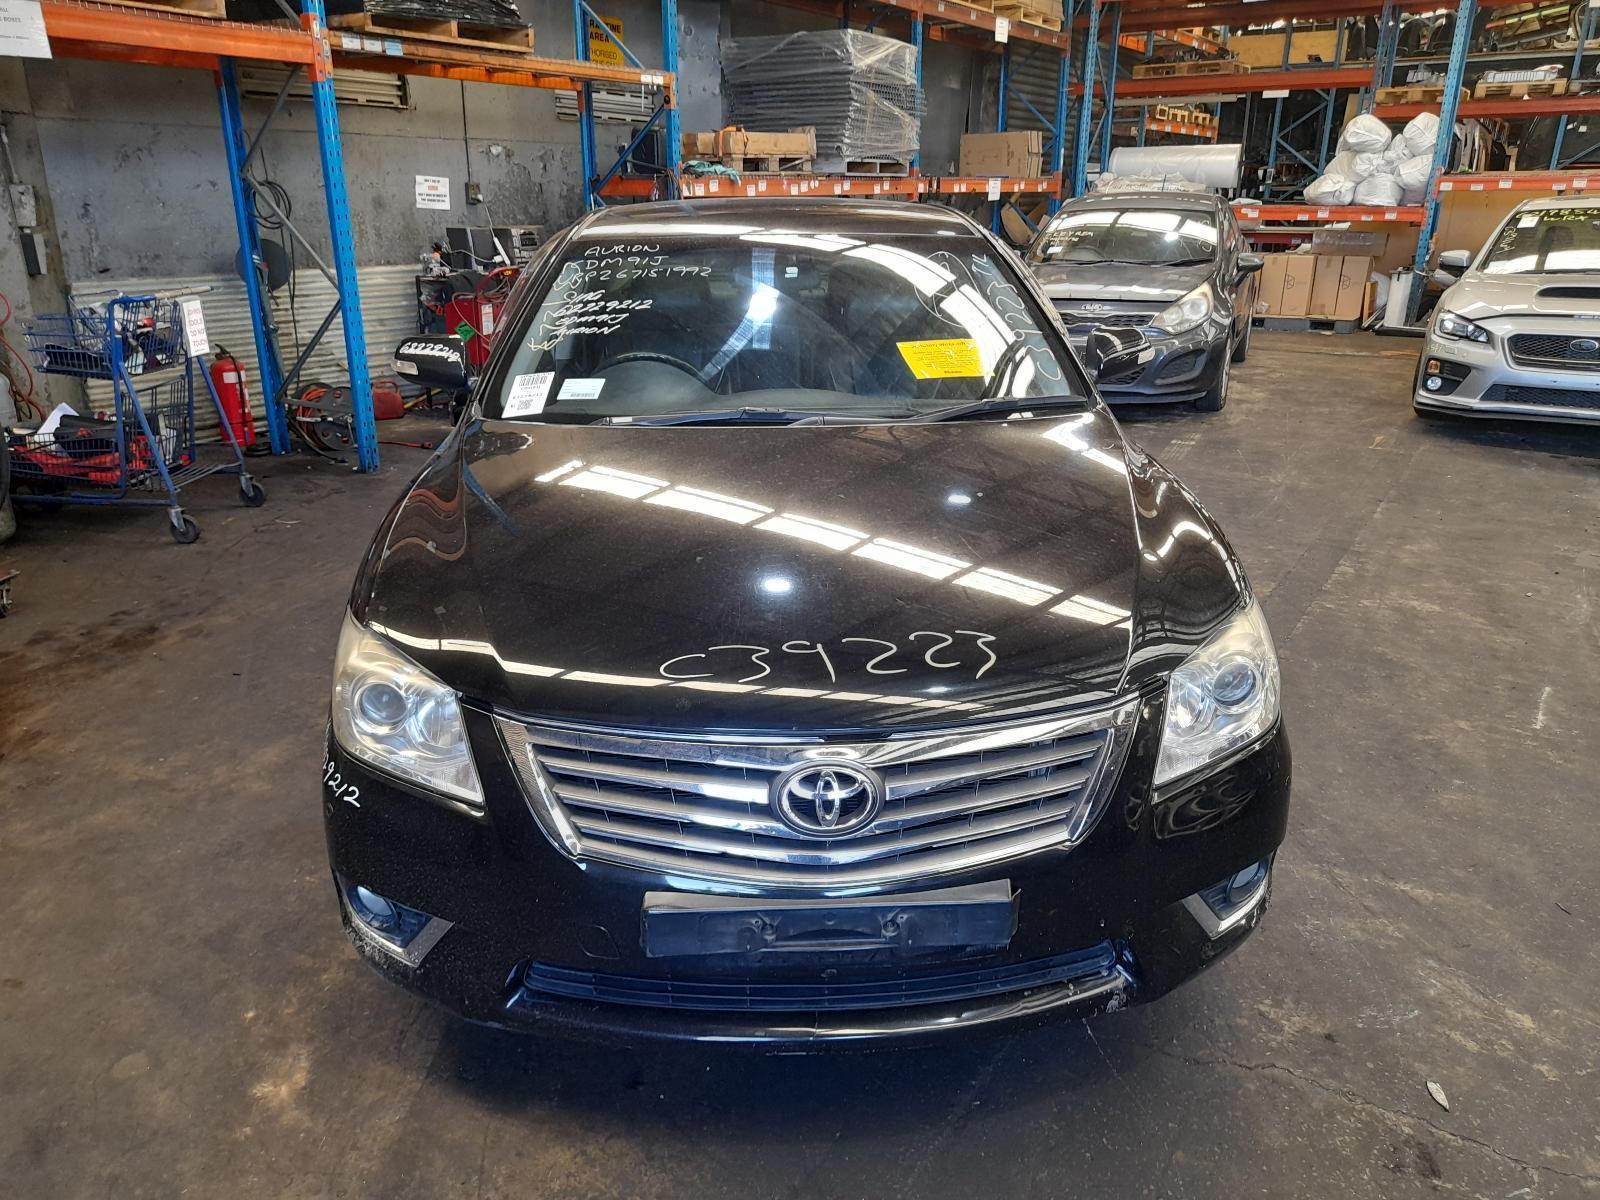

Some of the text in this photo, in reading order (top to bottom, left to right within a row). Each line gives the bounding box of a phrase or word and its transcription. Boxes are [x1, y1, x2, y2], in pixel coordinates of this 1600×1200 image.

[590, 31, 610, 43] AREA
[585, 244, 660, 257] AURION
[659, 629, 997, 684] C39223
